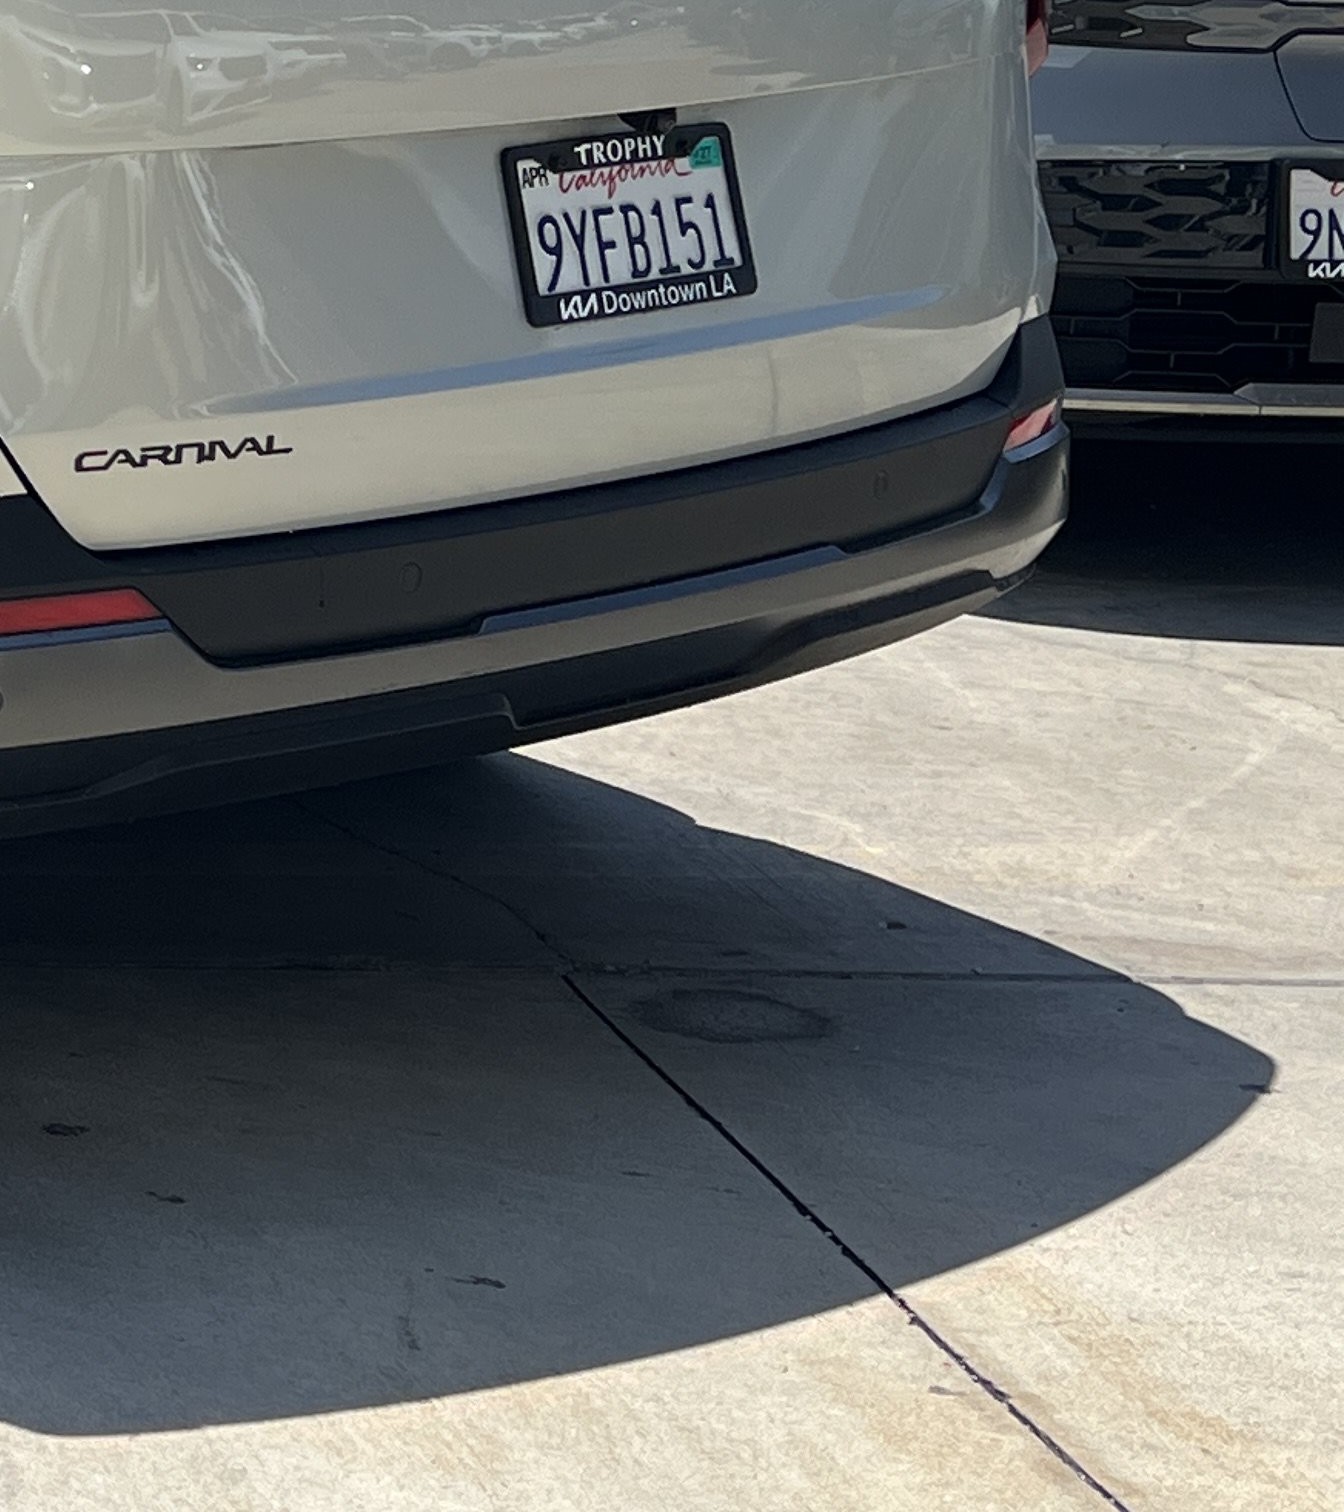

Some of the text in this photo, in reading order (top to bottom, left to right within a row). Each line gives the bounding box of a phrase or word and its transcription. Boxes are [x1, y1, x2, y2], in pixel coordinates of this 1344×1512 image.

[574, 134, 665, 165] TROPHY
[522, 166, 549, 188] APR
[537, 191, 735, 293] 9YFB151
[602, 279, 707, 314] Downtown
[709, 272, 737, 298] LA
[74, 435, 294, 473] CARNIVAL
